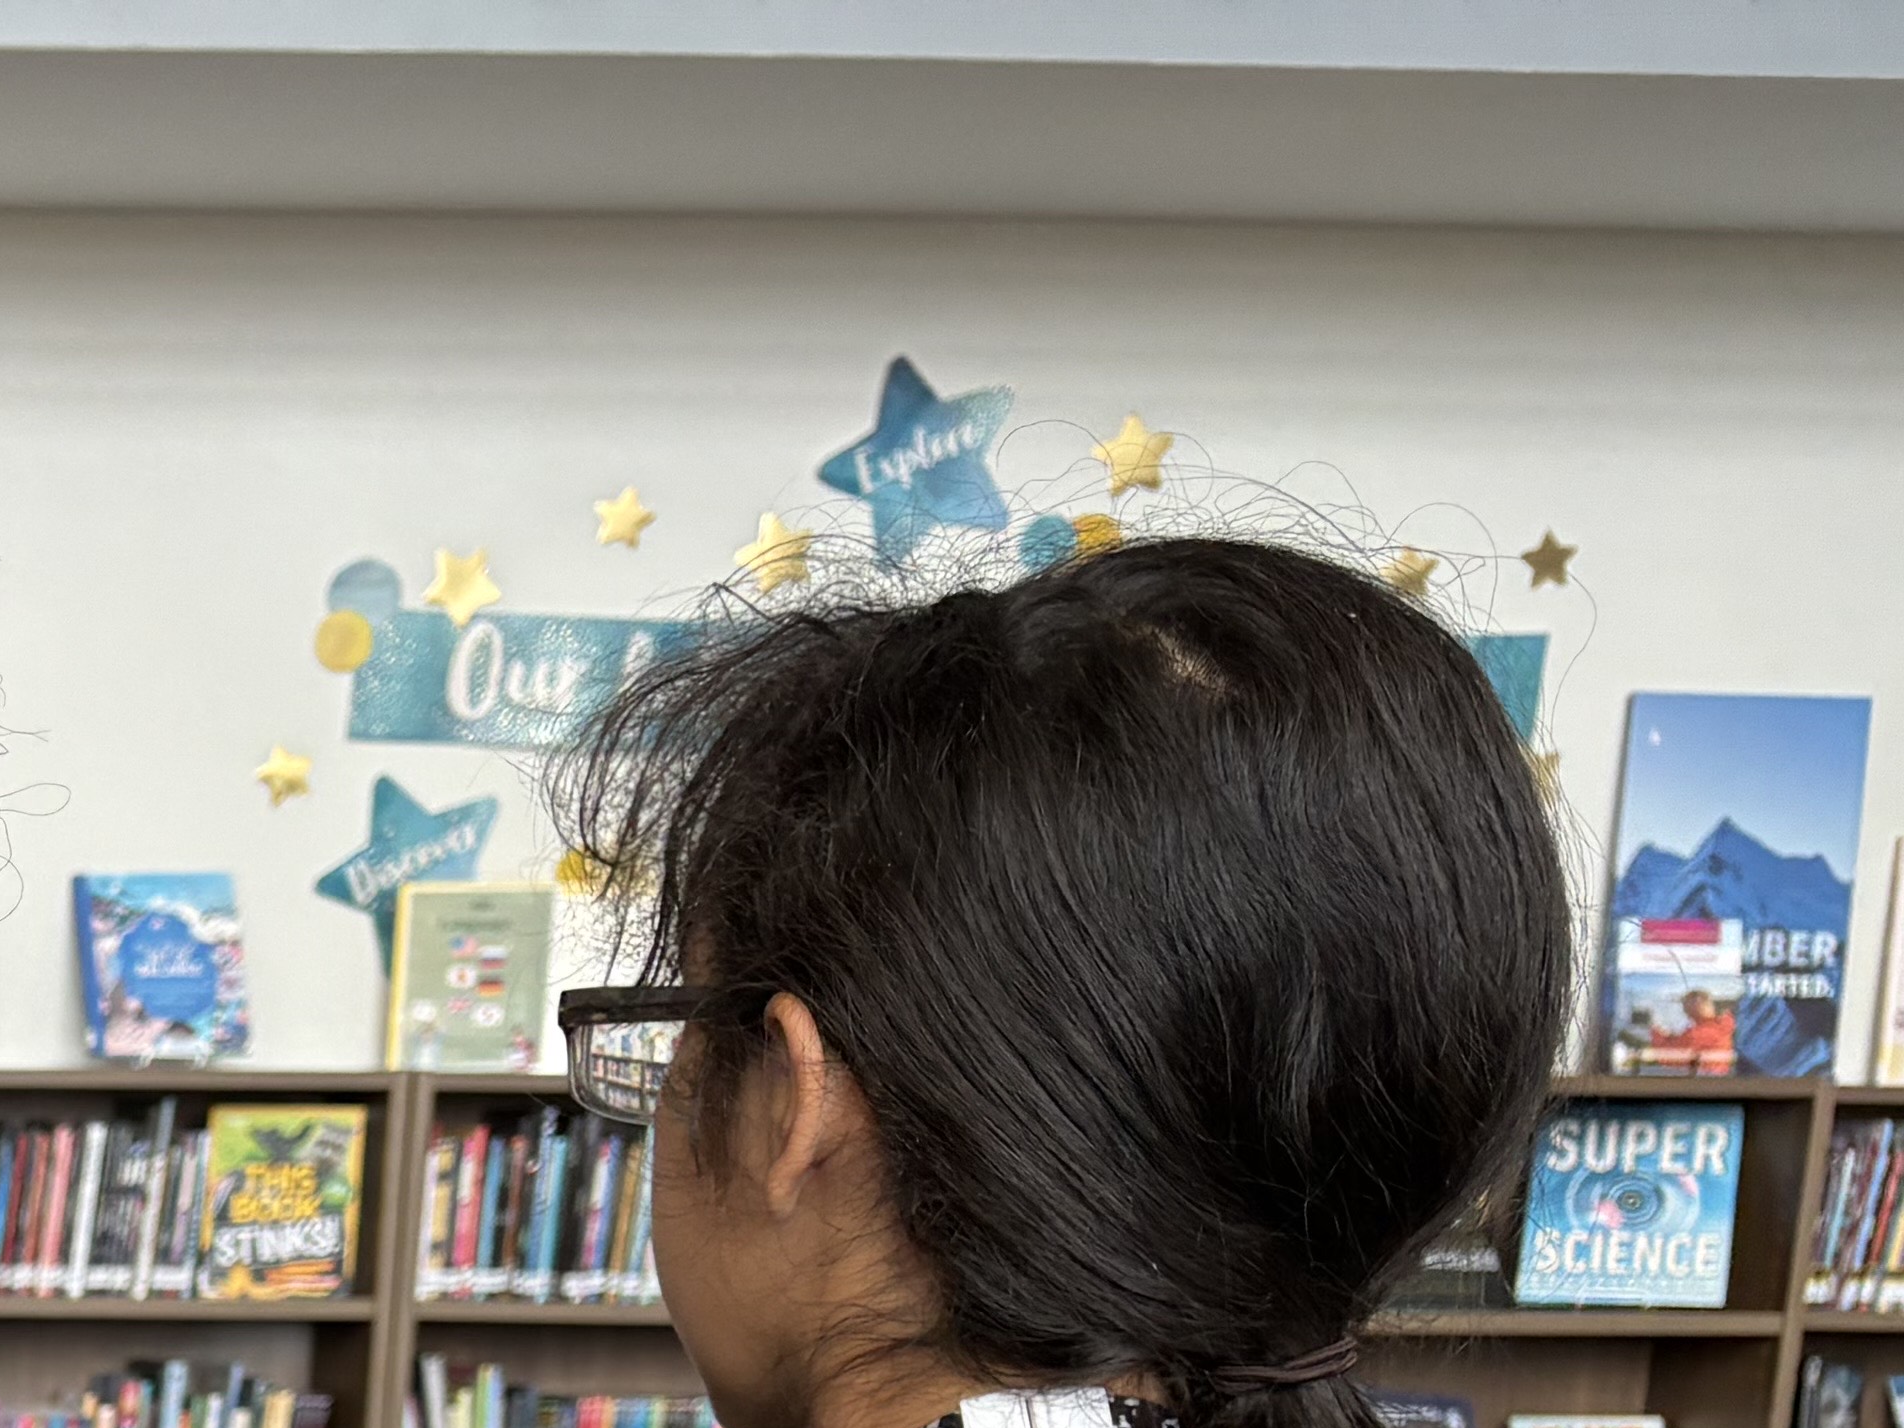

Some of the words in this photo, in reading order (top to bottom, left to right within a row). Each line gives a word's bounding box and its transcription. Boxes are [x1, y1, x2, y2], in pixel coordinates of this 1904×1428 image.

[1546, 1118, 1730, 1176] SUPER
[245, 1162, 316, 1197] THIS
[1534, 1229, 1722, 1277] SCIENCE
